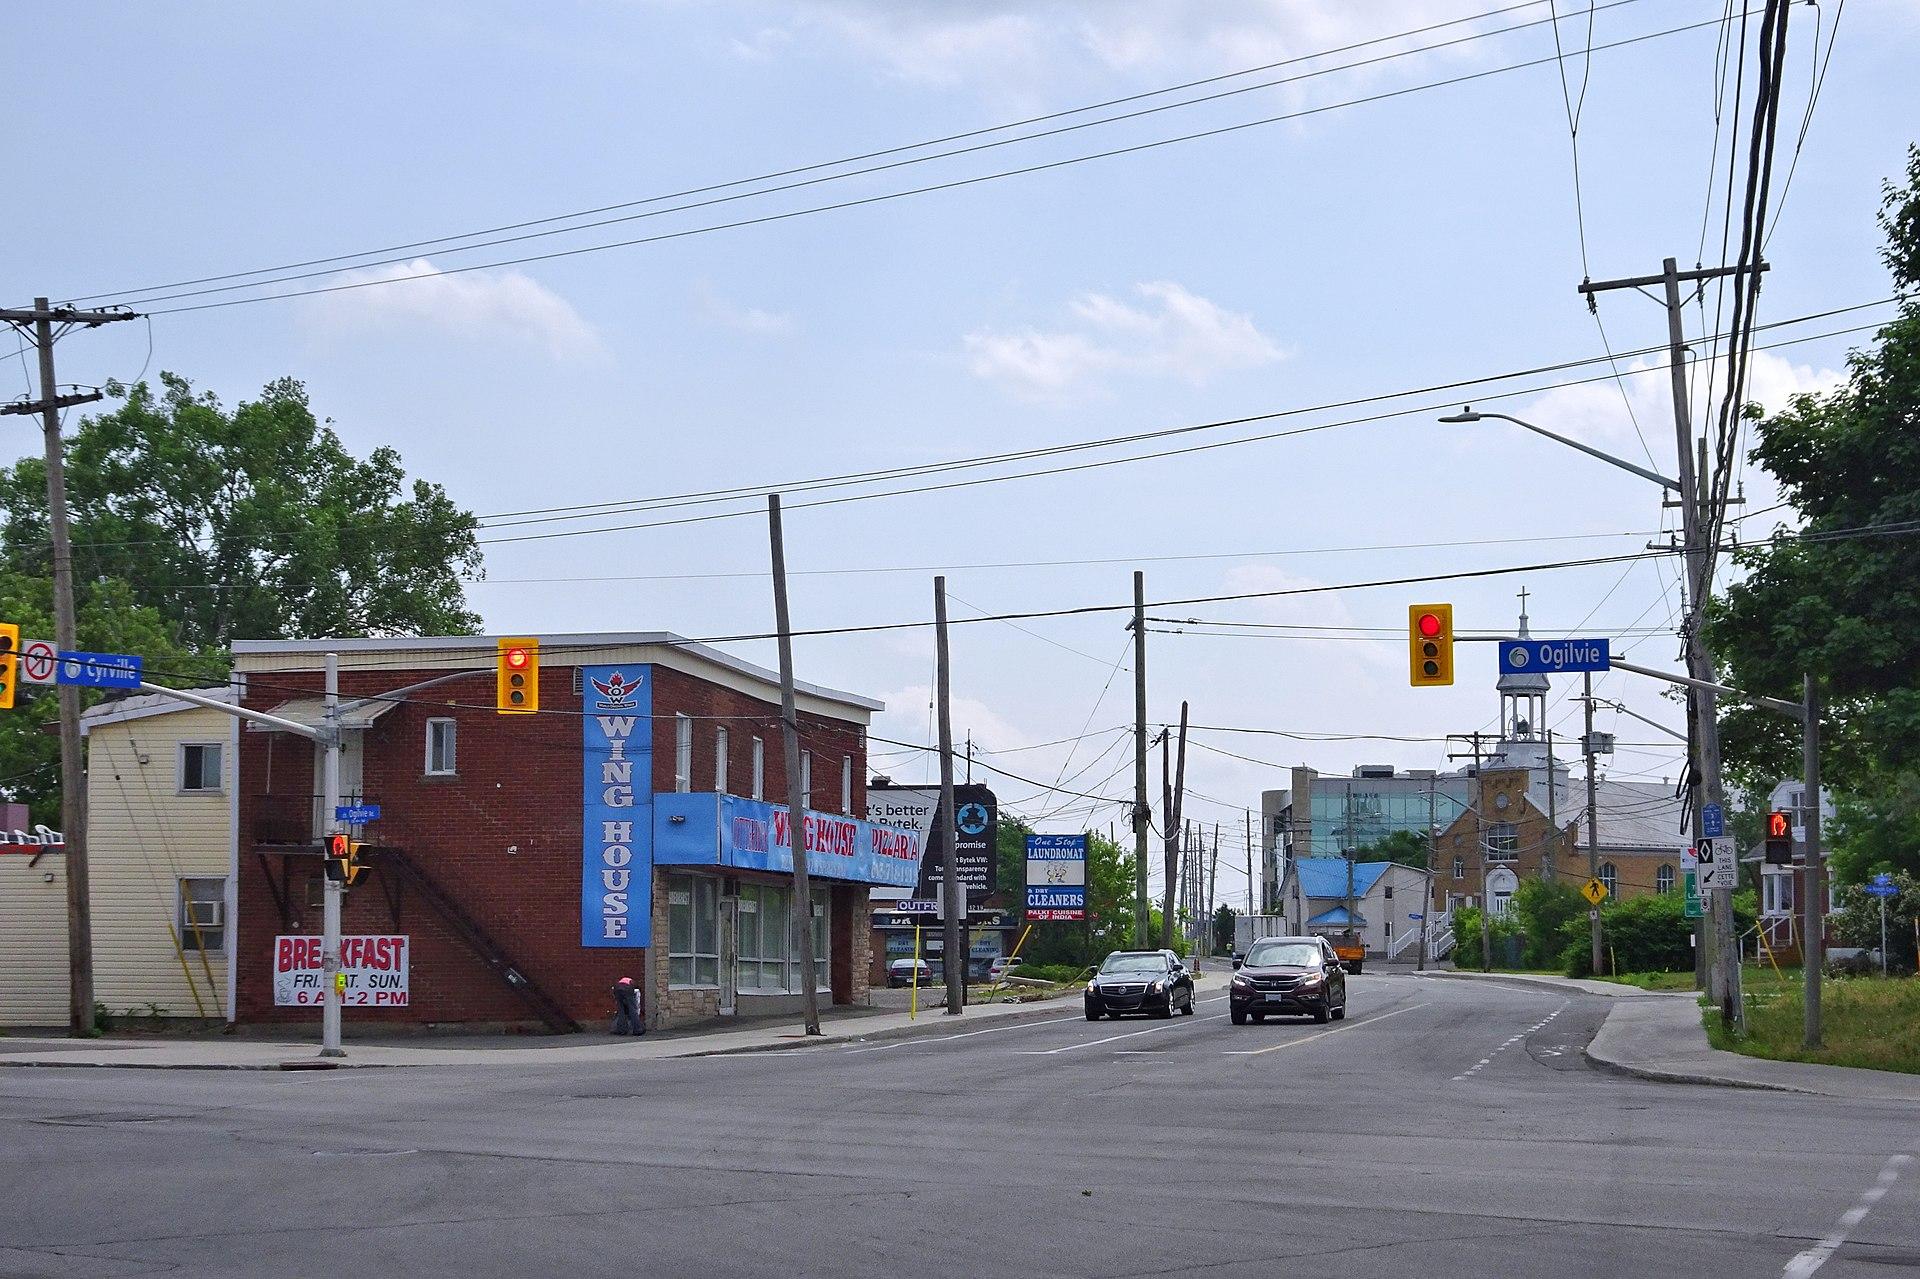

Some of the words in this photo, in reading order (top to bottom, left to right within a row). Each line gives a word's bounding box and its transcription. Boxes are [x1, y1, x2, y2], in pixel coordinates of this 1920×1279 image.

[1540, 642, 1600, 669] Ogilvie
[87, 657, 136, 683] Cyrville
[597, 716, 638, 808] WING
[886, 803, 928, 816] better
[774, 810, 814, 852] WIG
[815, 818, 857, 857] HOUSE
[1034, 837, 1051, 846] One
[1055, 837, 1076, 847] Stop
[1028, 848, 1084, 859] LAUNDROMAT
[601, 821, 633, 939] HOUSE
[1028, 895, 1084, 906] CLEANERS
[278, 937, 405, 973] BREKFAST
[294, 974, 320, 988] FRI.
[368, 974, 404, 988] SUN.
[297, 991, 308, 1004] 6
[375, 991, 407, 1005] PM
